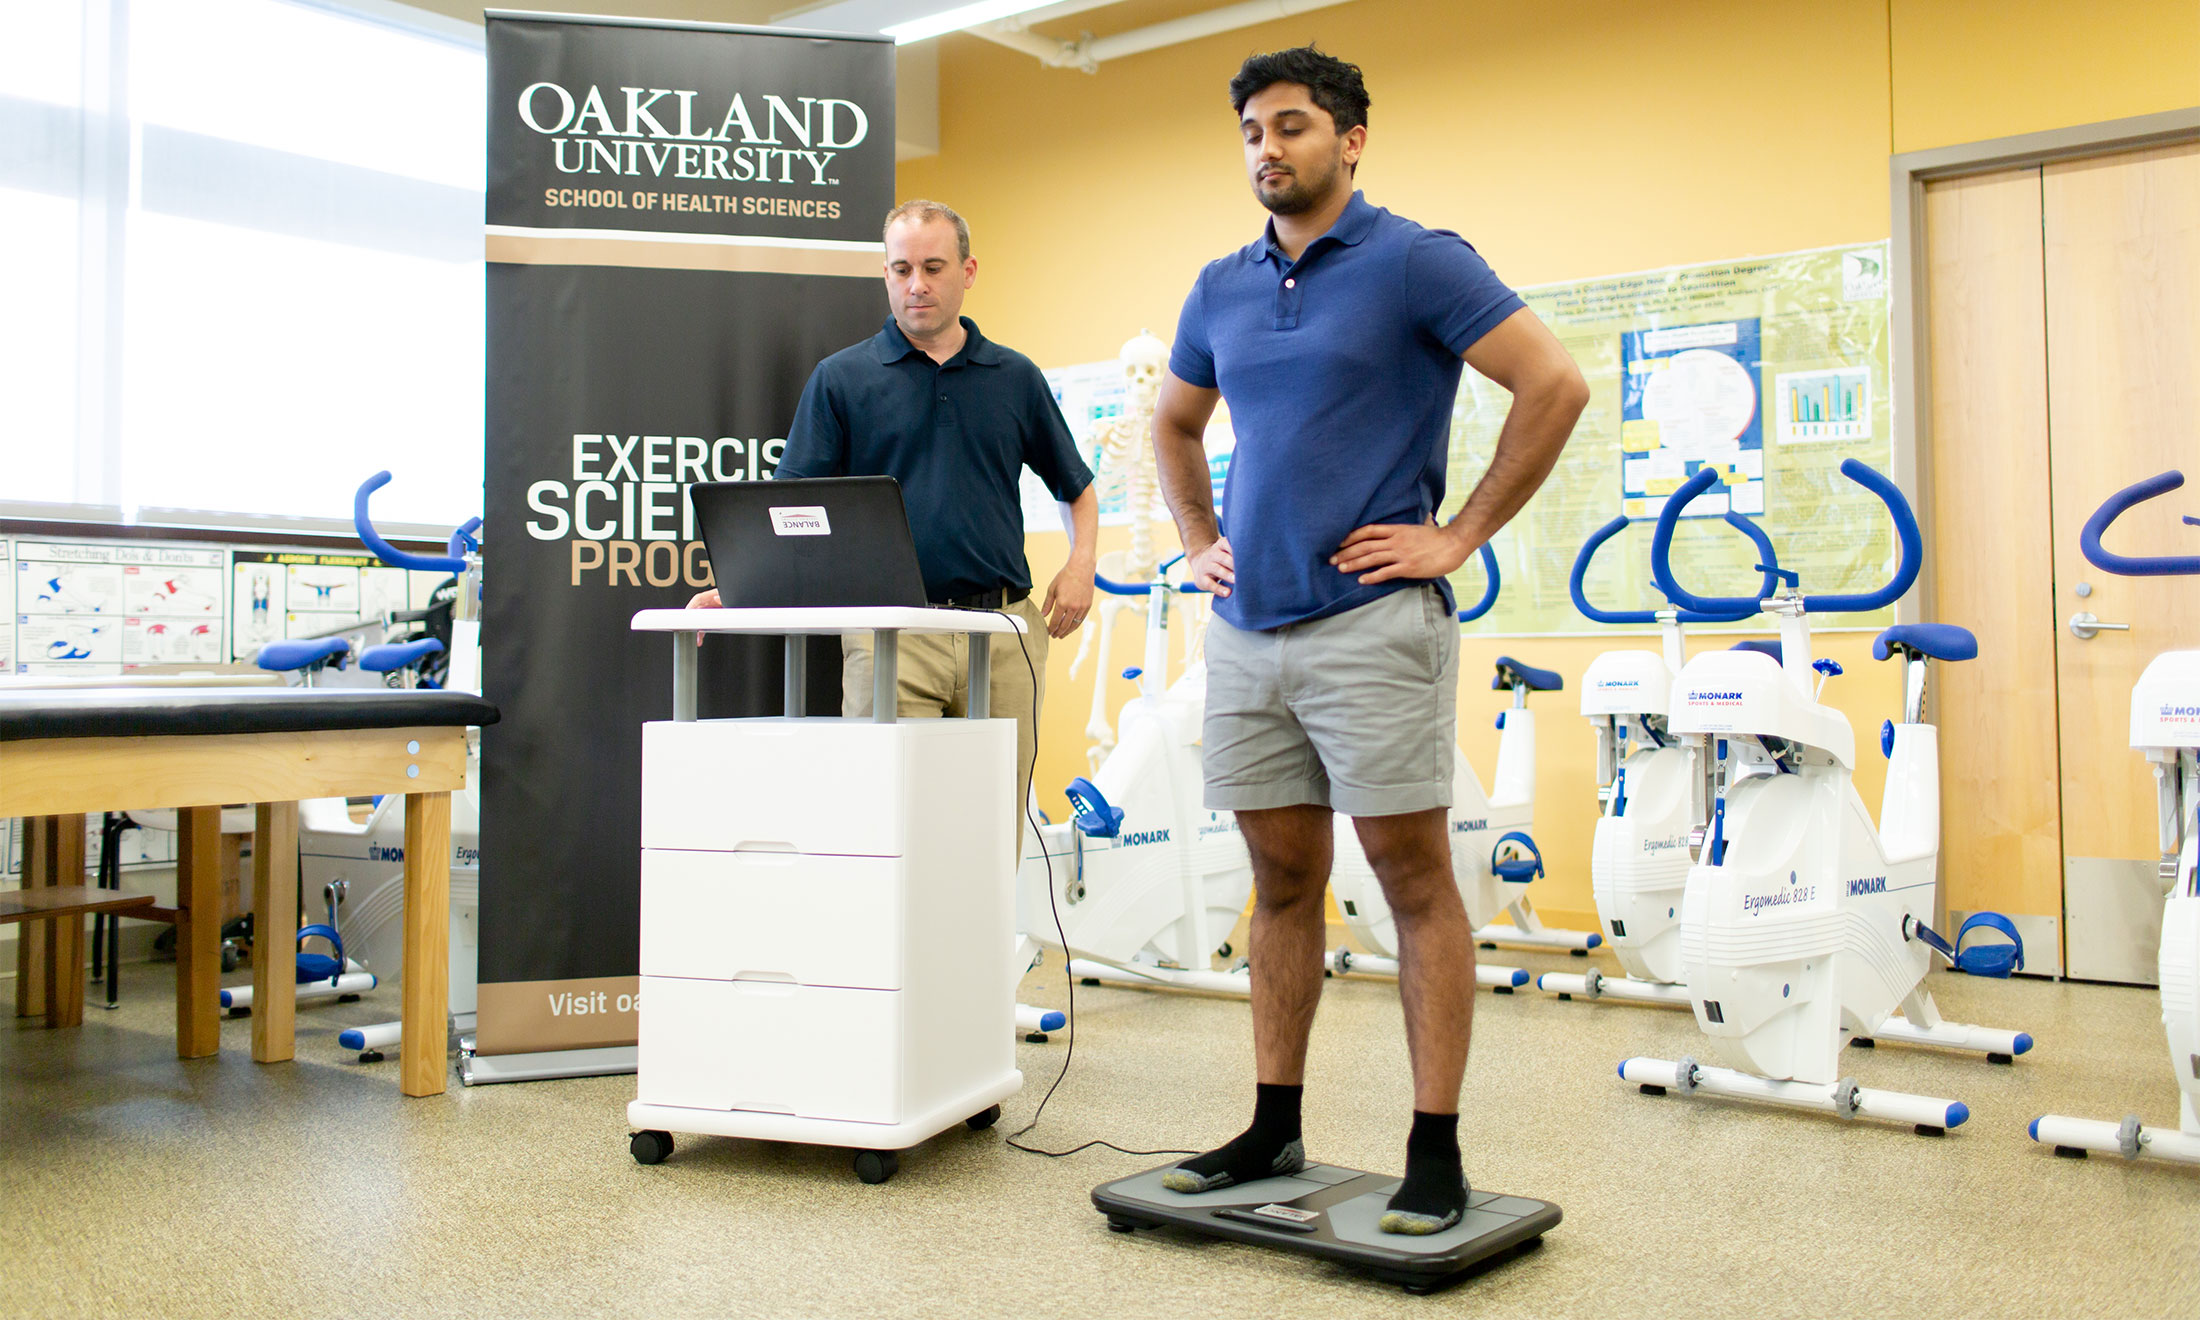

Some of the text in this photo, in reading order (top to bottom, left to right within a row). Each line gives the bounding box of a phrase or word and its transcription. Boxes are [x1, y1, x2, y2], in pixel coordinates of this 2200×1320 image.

[517, 81, 869, 149] OAKLAND
[551, 137, 837, 186] UNIVERSITY
[544, 187, 841, 220] SCHOOL OF HEALTH SCIENCES
[783, 520, 820, 528] BALANCE
[49, 545, 110, 561] Stretching
[1698, 692, 1743, 700] MONARK
[1123, 828, 1171, 848] MONARK
[1643, 836, 1689, 856] Ergomedic 828
[1849, 876, 1887, 897] MONARK
[1743, 885, 1816, 917] Ergomedic 828 E
[548, 991, 608, 1017] Visit
